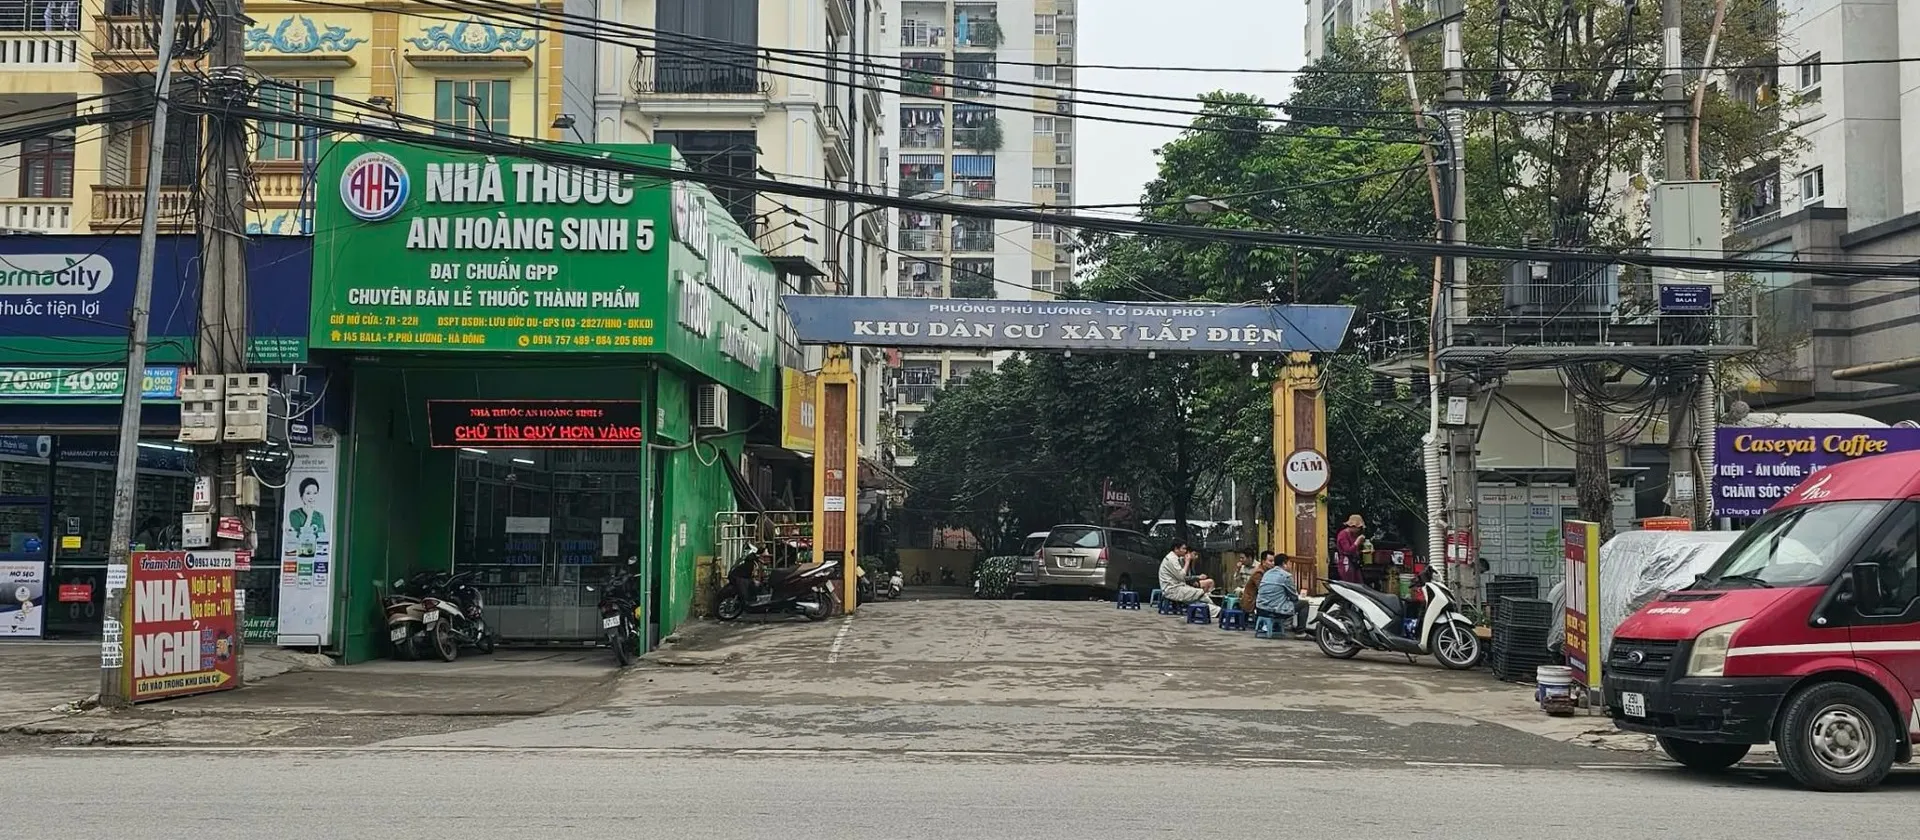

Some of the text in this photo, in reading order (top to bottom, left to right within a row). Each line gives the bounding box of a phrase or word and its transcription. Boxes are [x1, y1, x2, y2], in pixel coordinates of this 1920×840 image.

[350, 163, 400, 211] AHS
[426, 154, 505, 203] NHÀ
[406, 211, 654, 250] AN HOÀNG SINH 5
[0, 259, 101, 291] armacity
[430, 257, 559, 282] ĐẠT CHUẨN GPP
[348, 285, 640, 308] CHUYÊN BÁN LẺ THUỐC THÀNH PHẨM
[48, 300, 76, 318] tiện
[82, 300, 100, 318] lợi
[929, 303, 996, 313] PHƯỜNG
[1000, 305, 1033, 314] PHÚ
[1038, 305, 1092, 316] LƯƠNG
[1106, 305, 1126, 316] TỔ
[1132, 306, 1168, 316] DÂN
[1172, 306, 1204, 317] PHỐ
[1209, 310, 1216, 318] 1
[330, 313, 344, 324] GIỜ
[402, 316, 418, 326] 22H
[853, 318, 1284, 346] KHU DÂN CƯ XÂY LẮP ĐIỆN
[470, 408, 490, 417] NHÀ
[492, 407, 524, 417] THUỐC
[539, 407, 574, 417] HOÀNG
[576, 410, 598, 418] SINH
[455, 424, 642, 439] CHỮ TÍN QUÝ HƠN VÀNG
[1823, 434, 1888, 456] Coffee
[1290, 457, 1322, 472] CẤM
[1721, 464, 1744, 478] KIỆN
[1773, 462, 1800, 477] UỐNG
[1722, 483, 1756, 498] CHĂM
[1758, 482, 1781, 498] SÓC
[1727, 508, 1750, 516] Chung
[135, 572, 192, 624] NHÀ
[243, 618, 258, 628] OÀN
[134, 620, 200, 678] NGHỈ
[164, 678, 184, 690] TRONG
[185, 676, 198, 686] KHU
